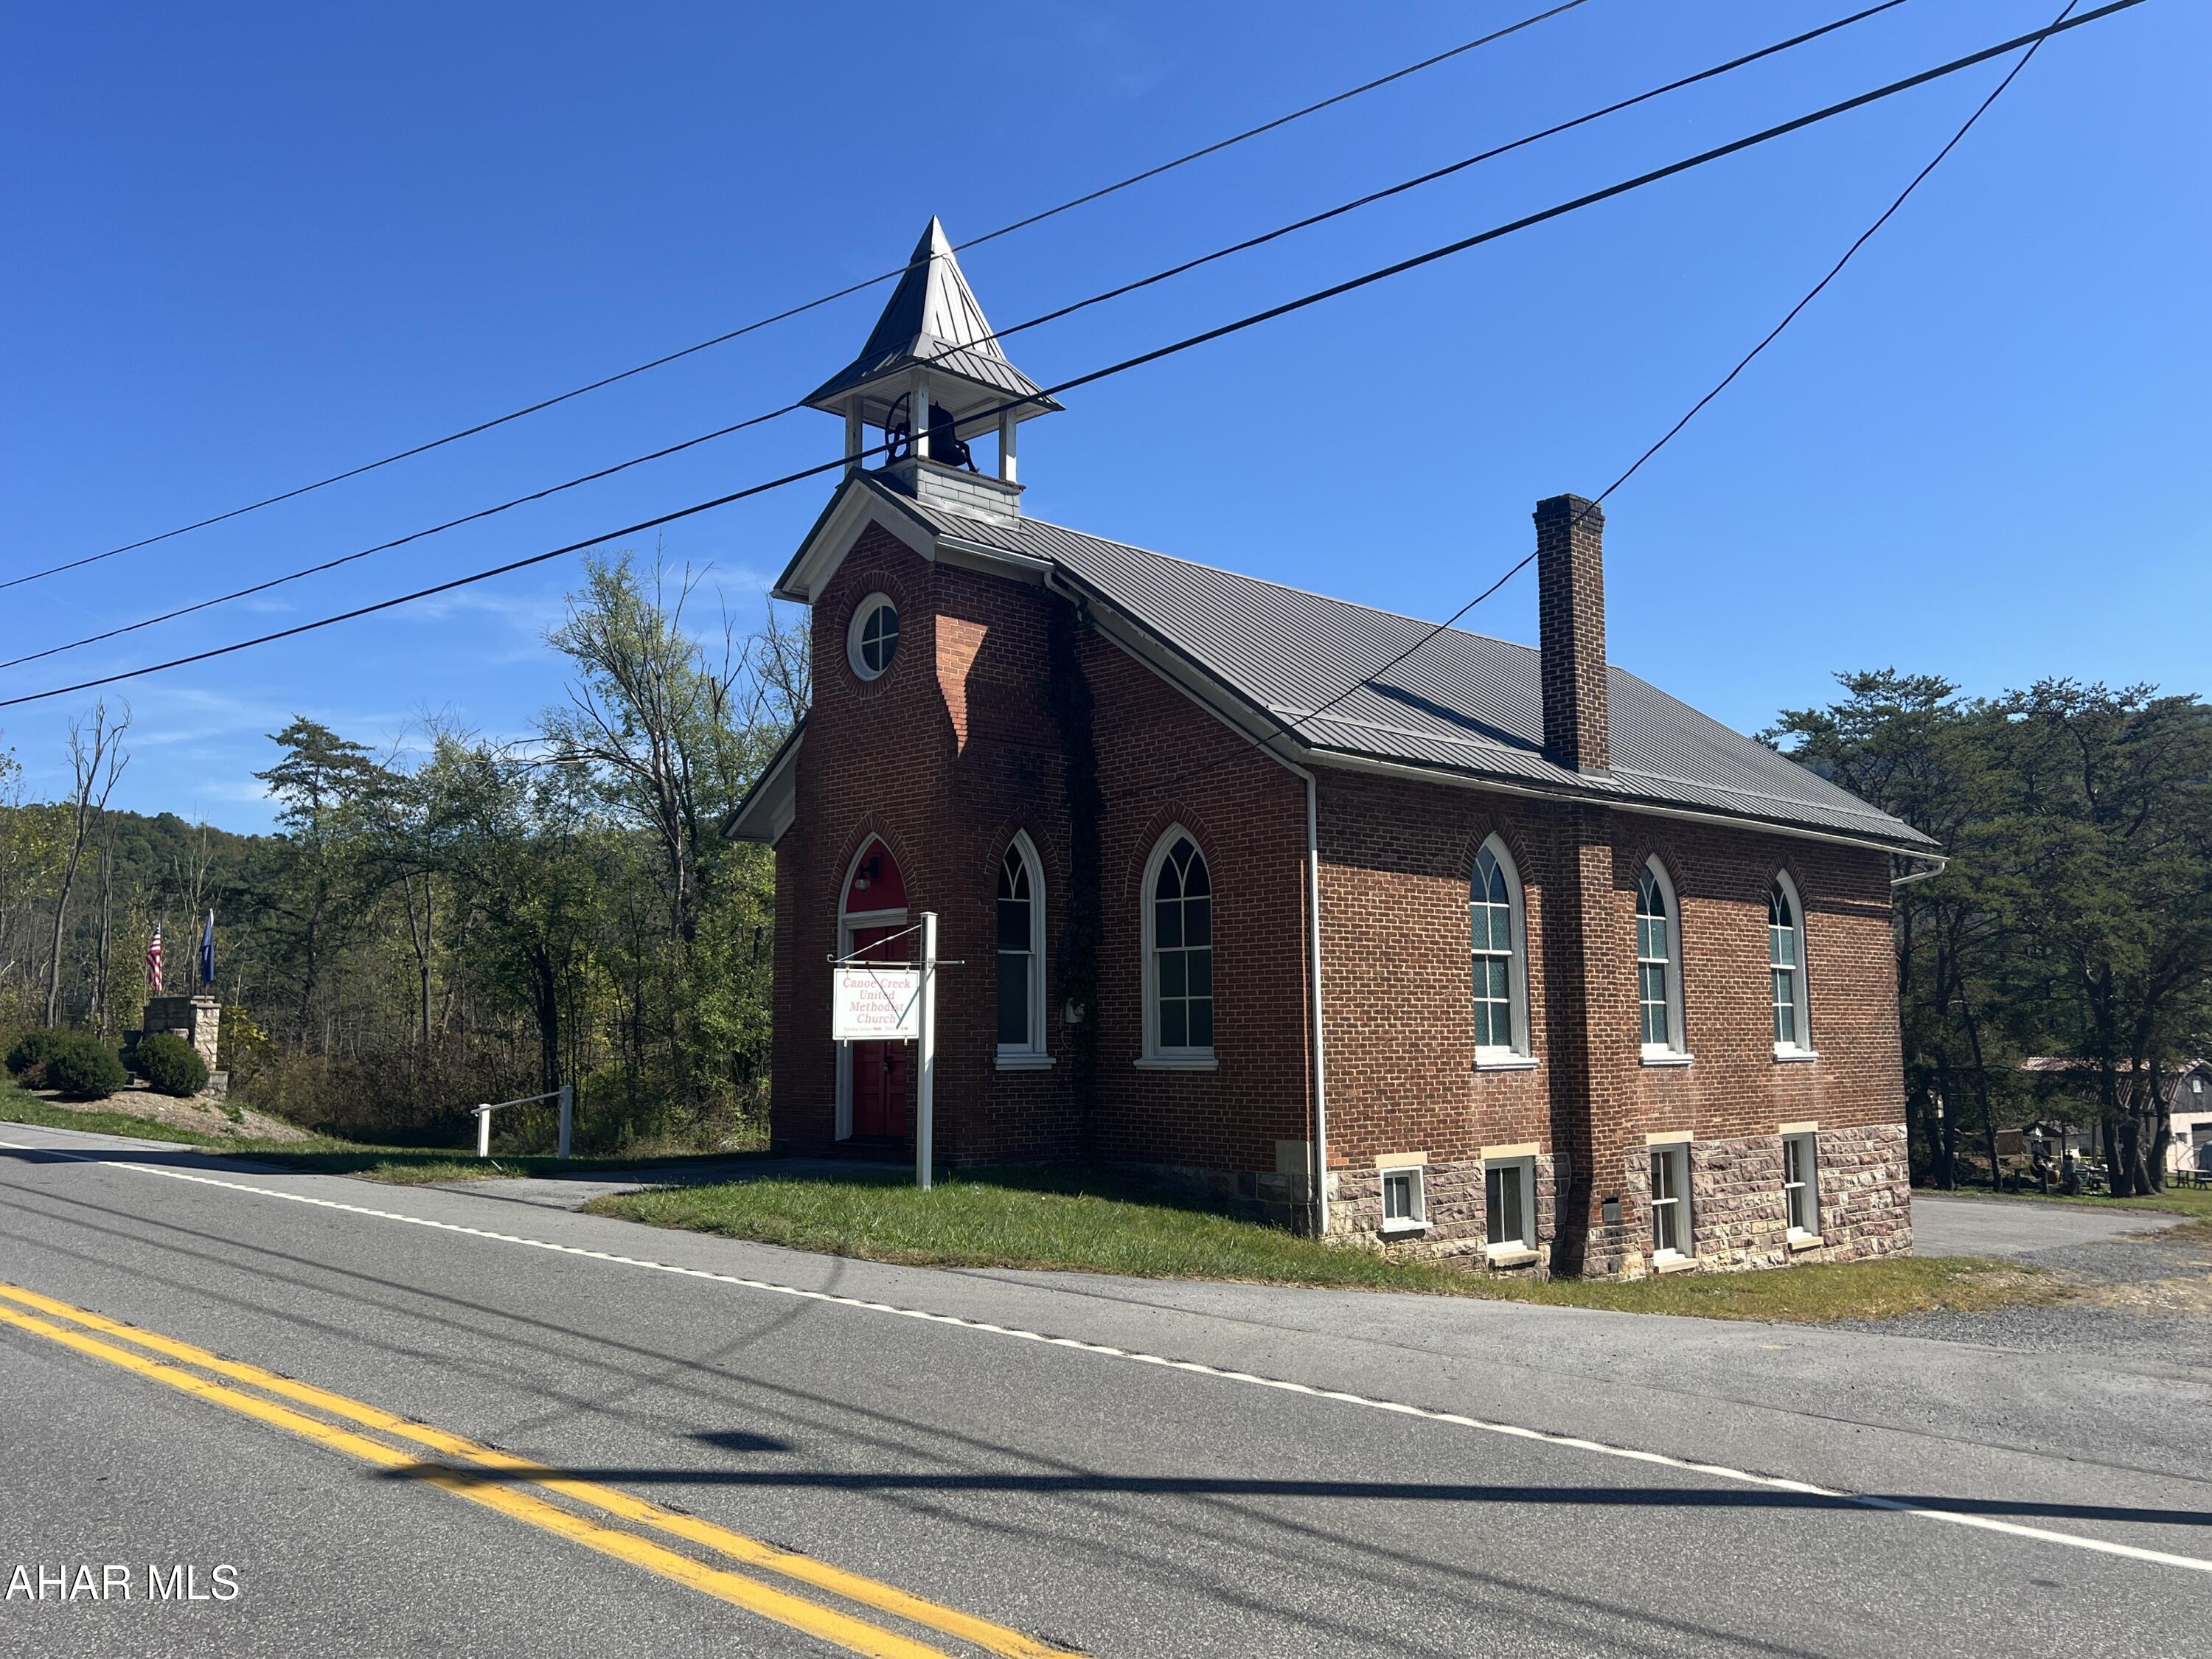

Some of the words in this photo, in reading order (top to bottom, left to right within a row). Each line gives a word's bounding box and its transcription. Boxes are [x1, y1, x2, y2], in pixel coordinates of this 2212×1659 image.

[843, 978, 877, 988] Canoe
[880, 978, 911, 989] Creek
[860, 990, 895, 1000] United
[849, 1002, 904, 1012] Methodist
[857, 1013, 896, 1023] Church
